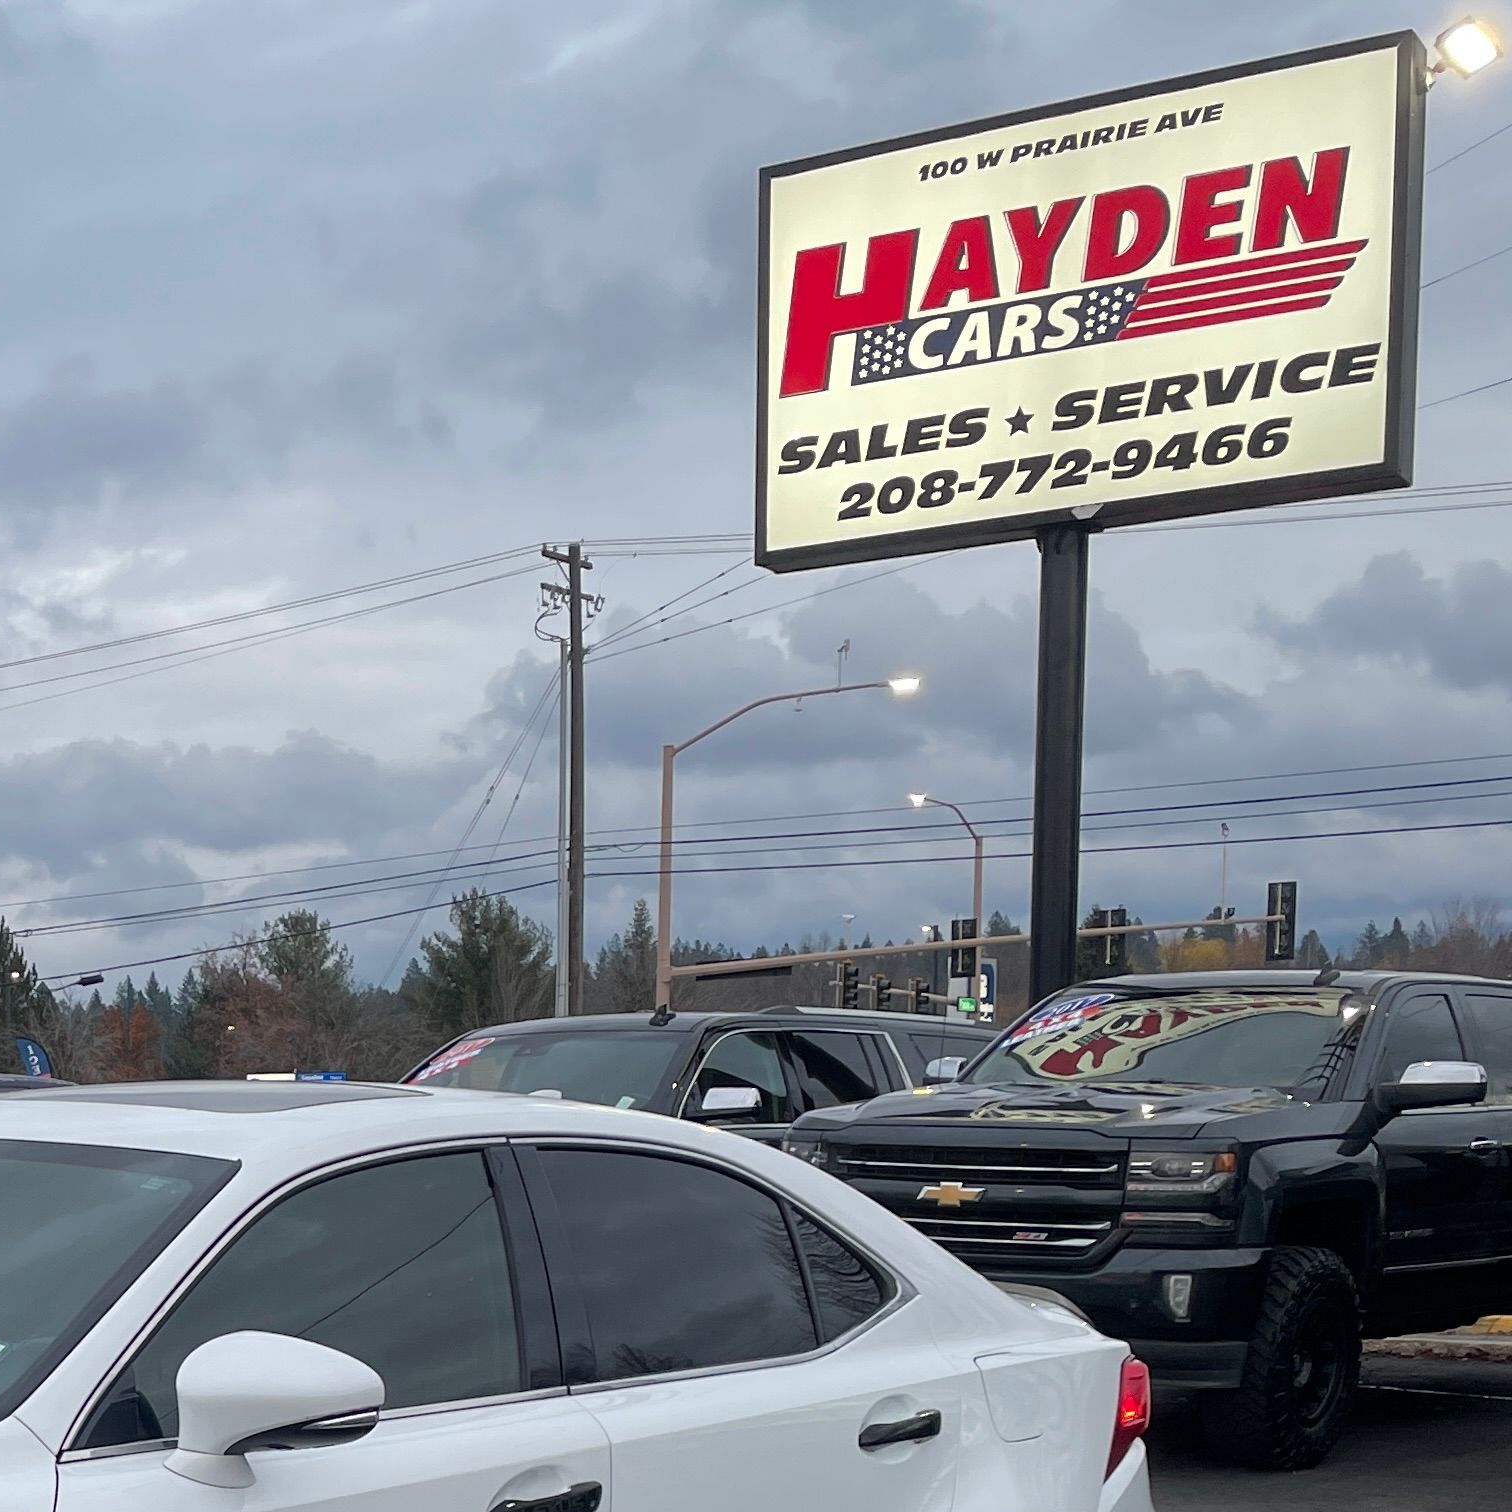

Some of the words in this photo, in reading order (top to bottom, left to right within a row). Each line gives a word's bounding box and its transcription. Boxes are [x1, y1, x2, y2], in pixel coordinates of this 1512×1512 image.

[919, 158, 968, 182] 100
[977, 149, 1005, 170] W
[1010, 119, 1149, 164] PRAIRIE
[1154, 103, 1225, 134] AVE
[779, 147, 1351, 398] HAYDEN
[908, 295, 1084, 370] CARS
[778, 408, 989, 475] SALES
[1051, 343, 1381, 432] SERVICE
[837, 417, 1292, 521] 208-772-9466
